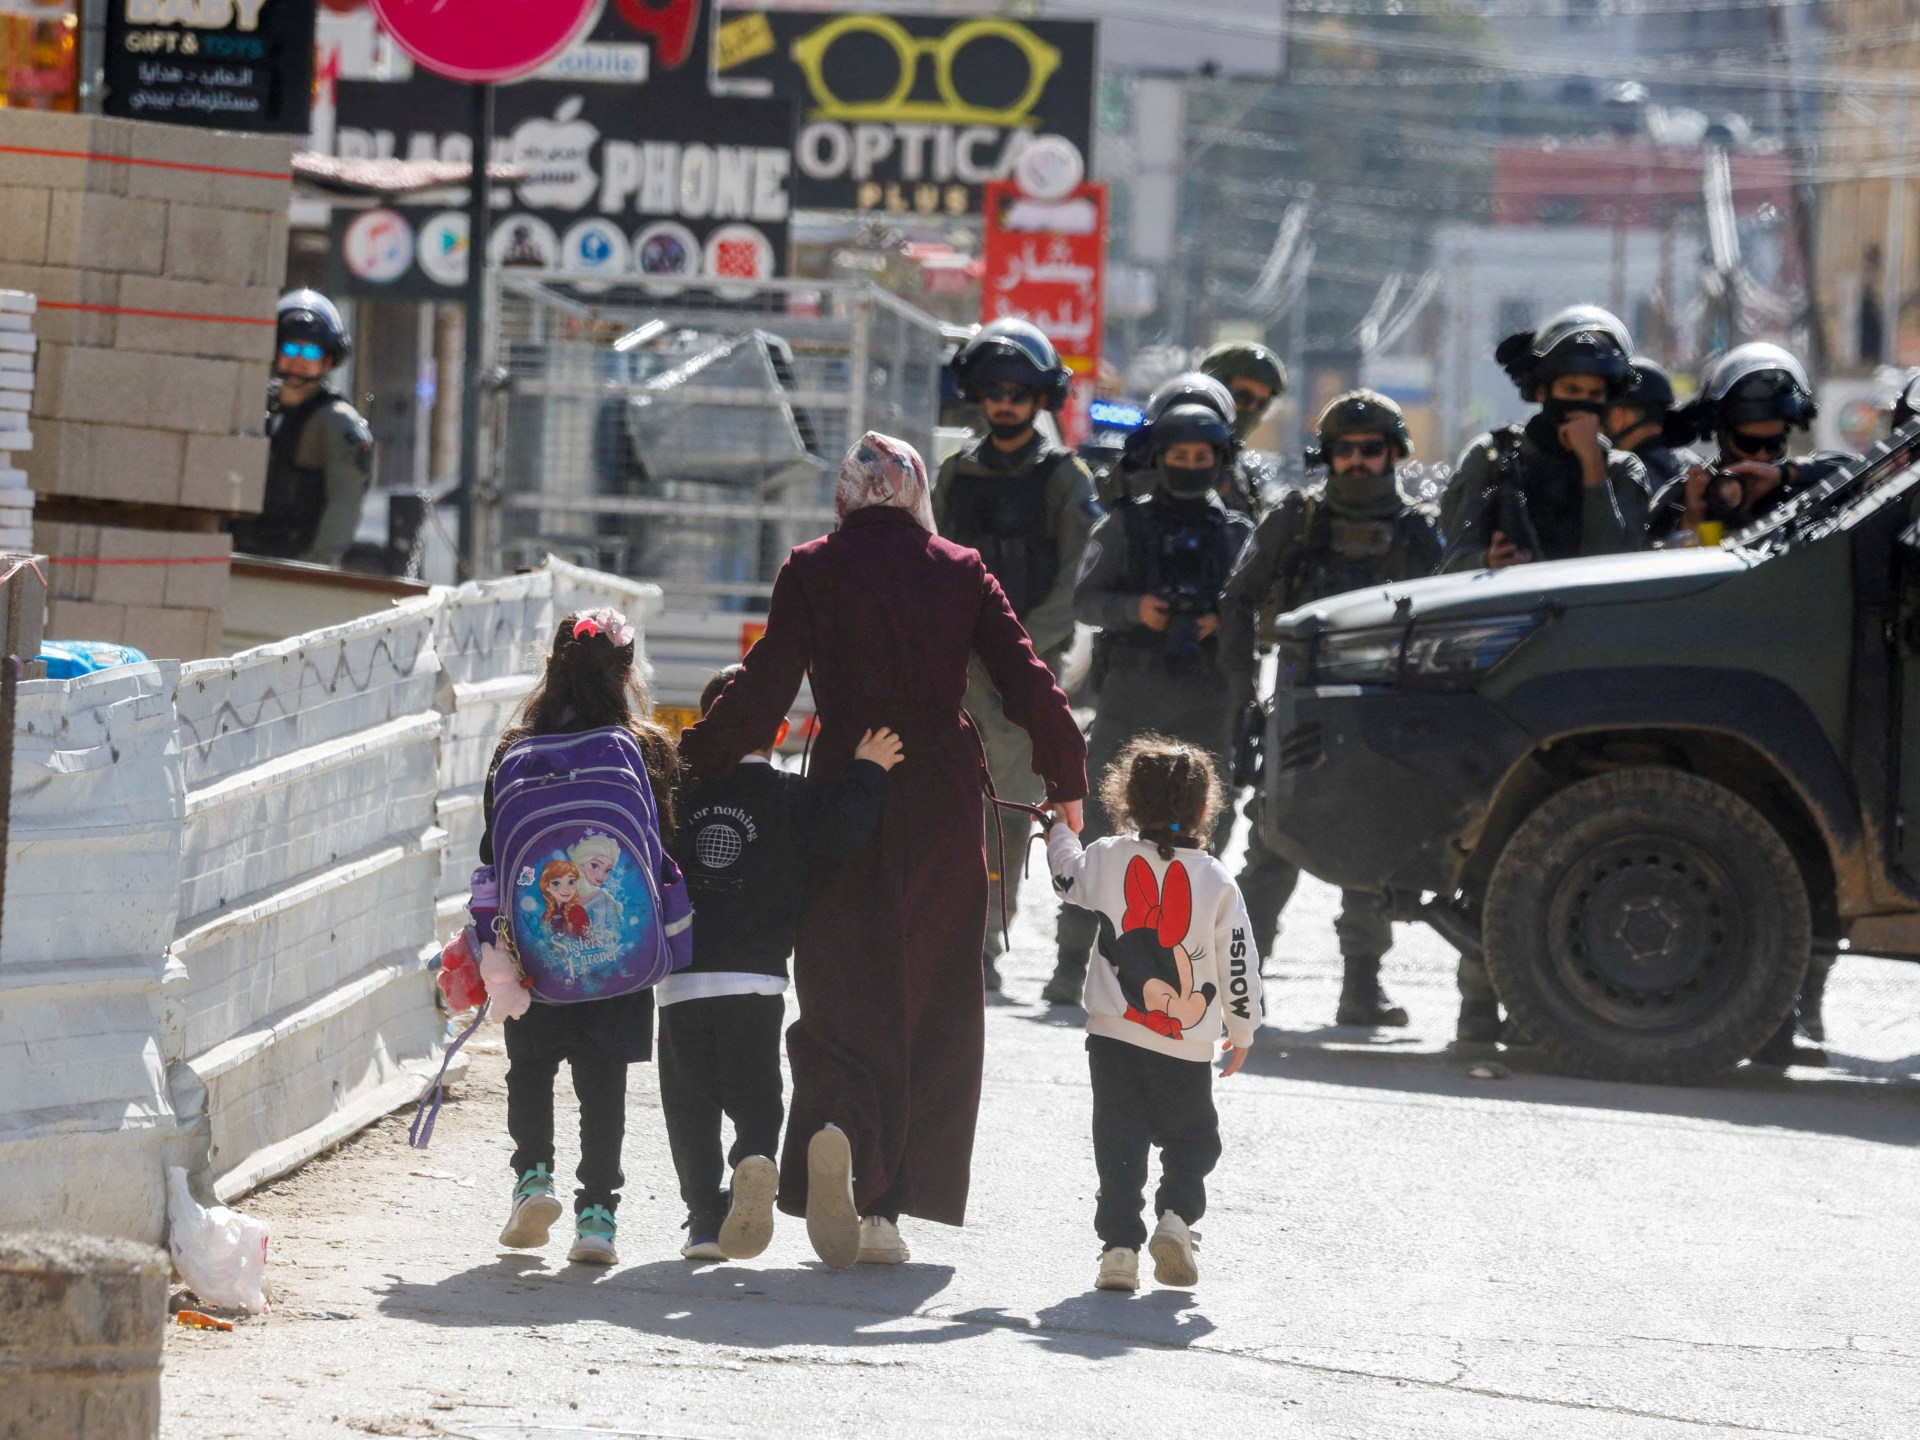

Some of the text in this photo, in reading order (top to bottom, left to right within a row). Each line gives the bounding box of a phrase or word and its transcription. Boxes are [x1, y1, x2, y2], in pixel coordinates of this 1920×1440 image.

[203, 34, 263, 58] TOYS
[600, 140, 791, 221] PHONE
[859, 182, 968, 214] PLUS
[693, 806, 758, 842] or nothing
[551, 932, 605, 957] Sisters
[1229, 927, 1251, 1019] MOUSE
